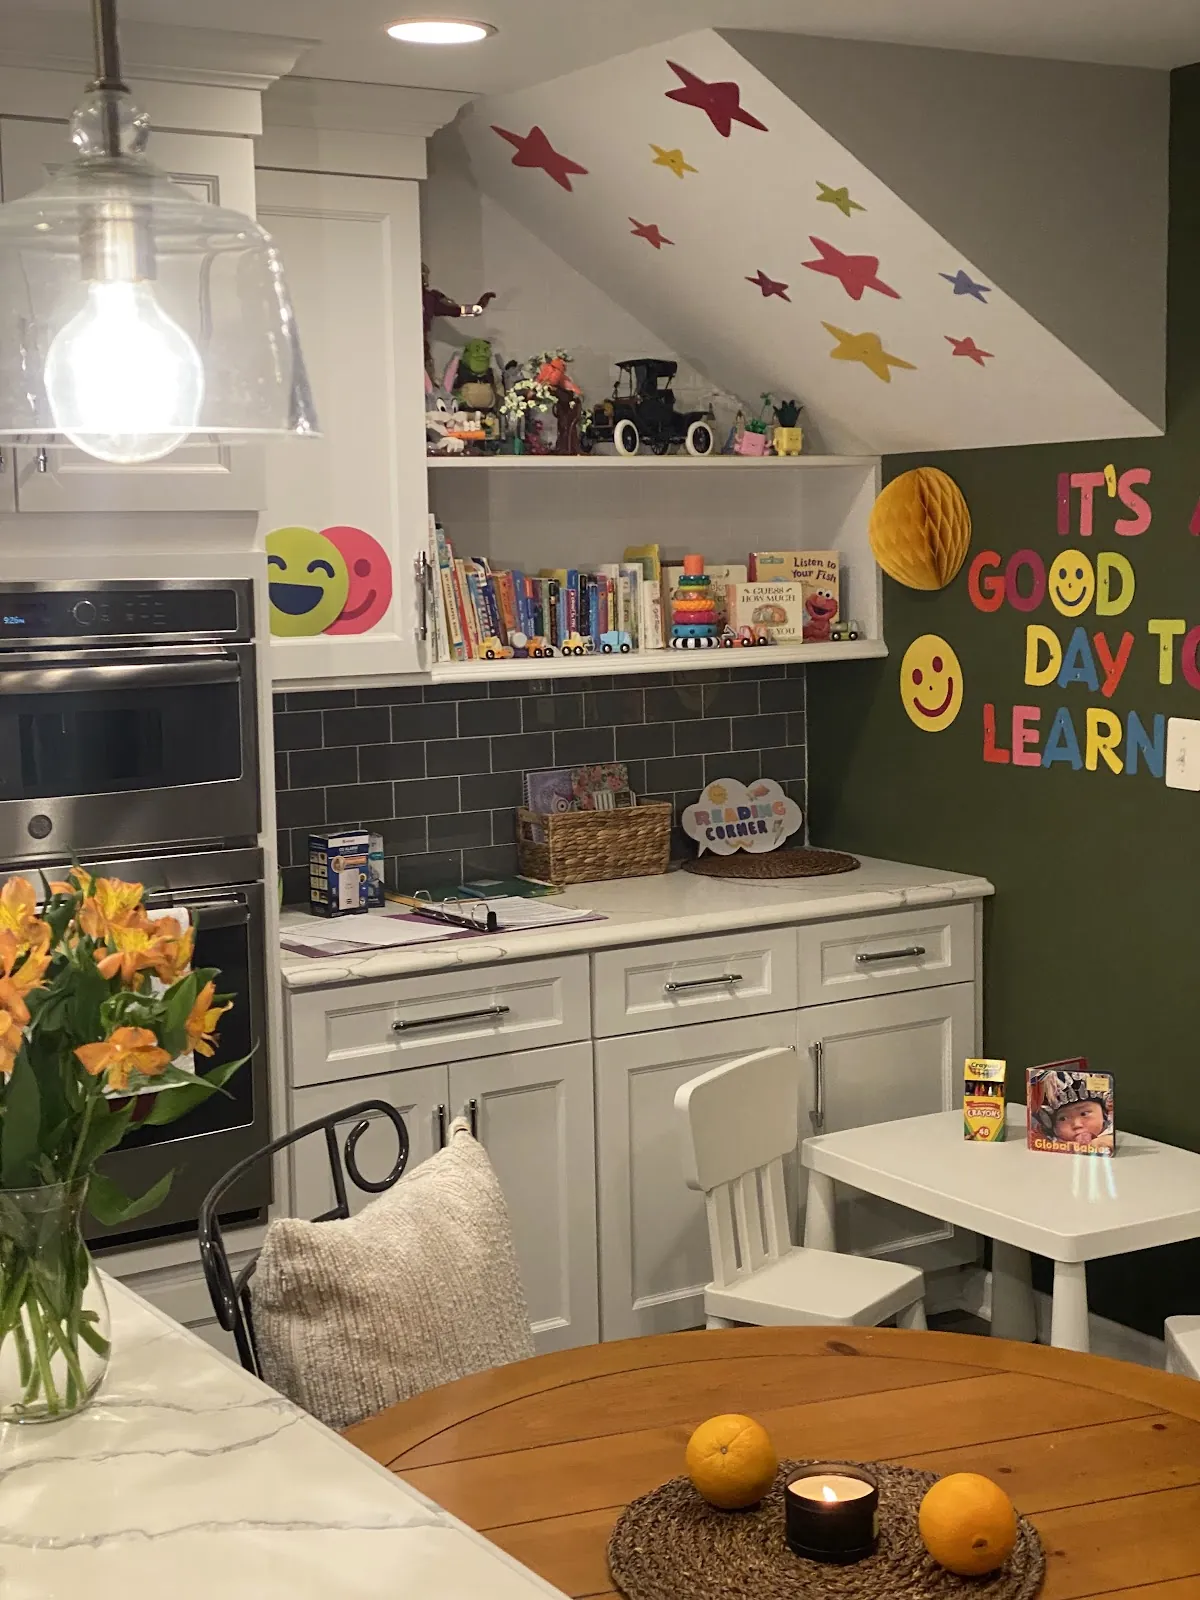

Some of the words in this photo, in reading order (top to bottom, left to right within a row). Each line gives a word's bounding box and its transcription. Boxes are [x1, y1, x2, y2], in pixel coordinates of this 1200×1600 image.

[1057, 464, 1151, 536] IT'S
[793, 557, 823, 567] Listen
[827, 560, 836, 569] to
[791, 569, 813, 578] Your
[815, 570, 836, 584] Fish
[742, 594, 764, 602] HOW
[765, 594, 796, 602] MUCH
[752, 587, 784, 595] GUESS
[1024, 625, 1134, 698] DAY
[983, 703, 1165, 778] LEARN
[694, 801, 786, 826] READING
[705, 820, 768, 841] CORNER
[967, 1109, 1001, 1119] CRAYONS
[979, 1128, 989, 1136] 48
[1034, 1138, 1071, 1151] Global
[1073, 1142, 1111, 1155] Babies
